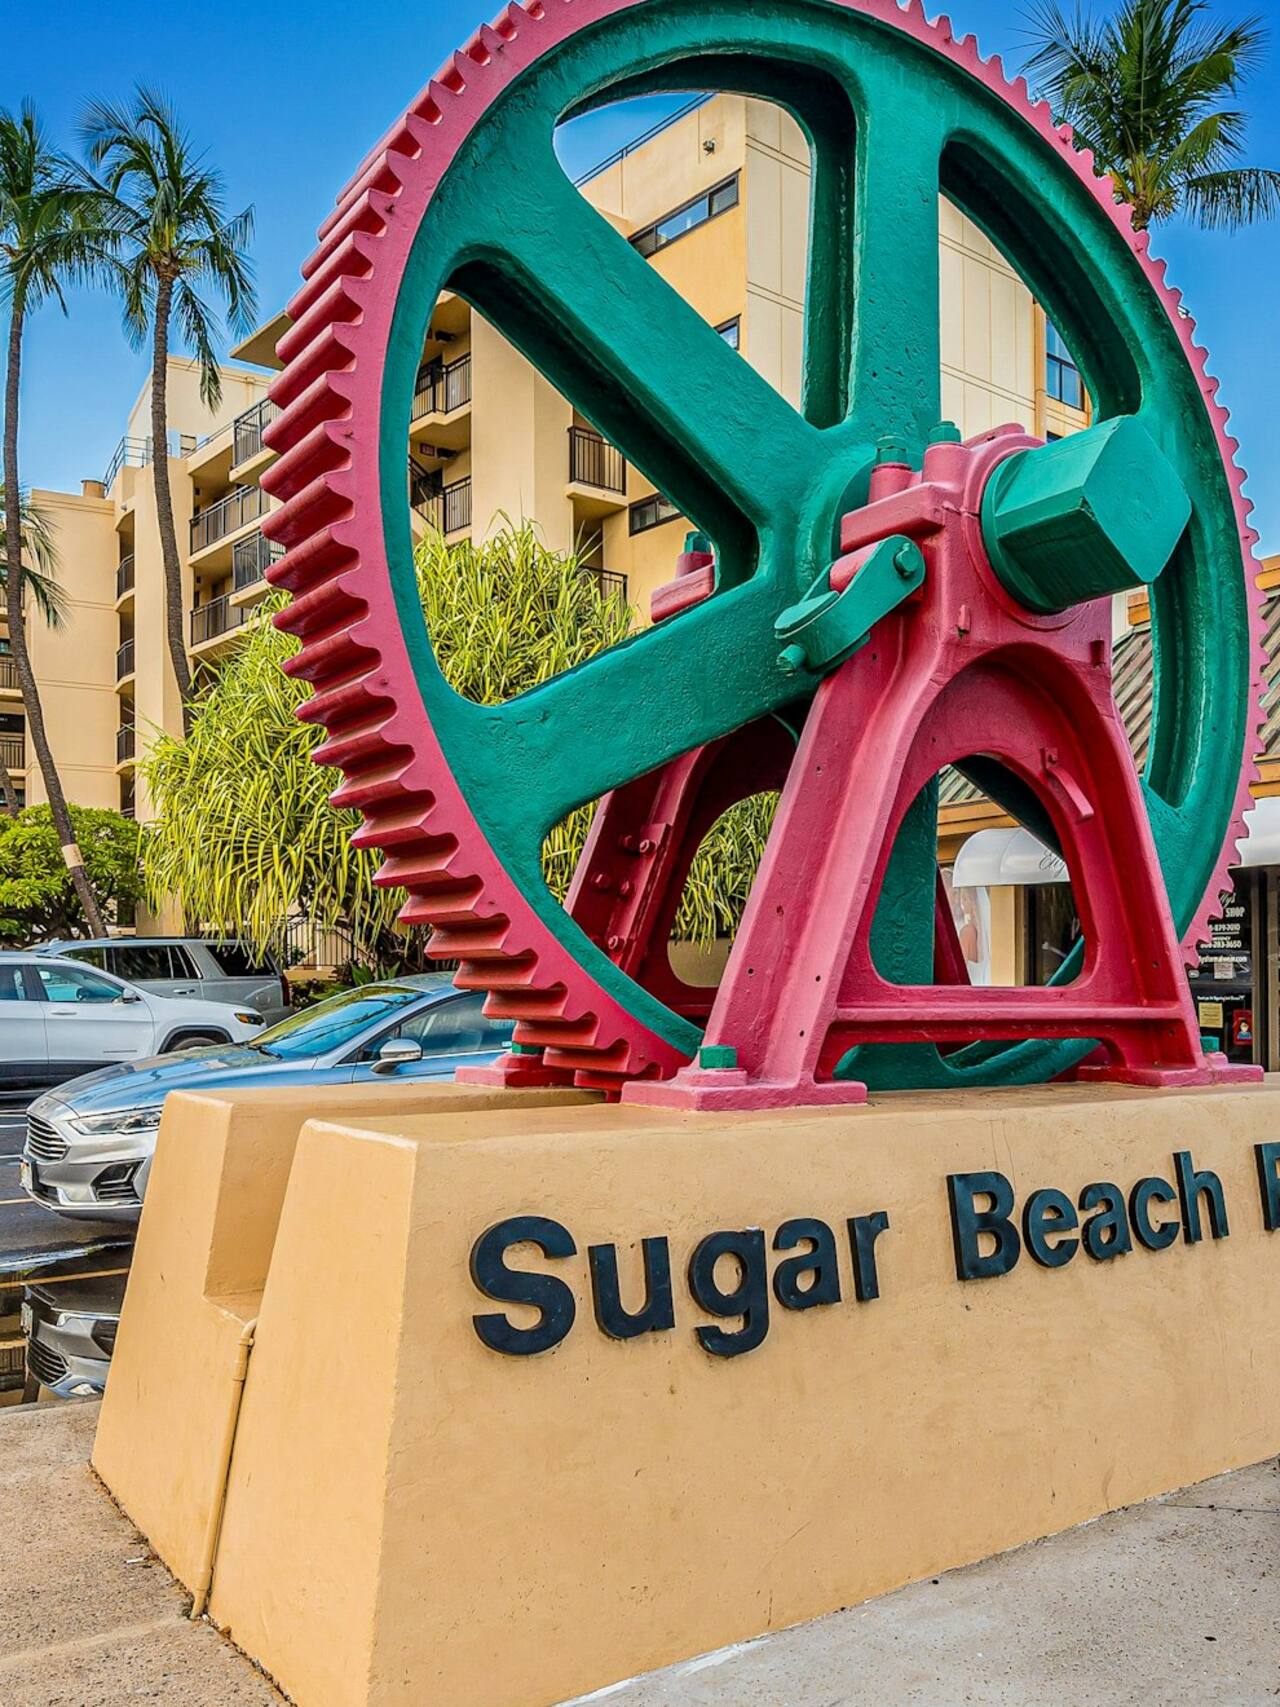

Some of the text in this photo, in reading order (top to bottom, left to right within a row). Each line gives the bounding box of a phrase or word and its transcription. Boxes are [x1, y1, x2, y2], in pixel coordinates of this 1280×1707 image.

[1225, 907, 1245, 917] SHOP
[469, 1211, 888, 1358] Sugar
[947, 1150, 1229, 1281] Beach
